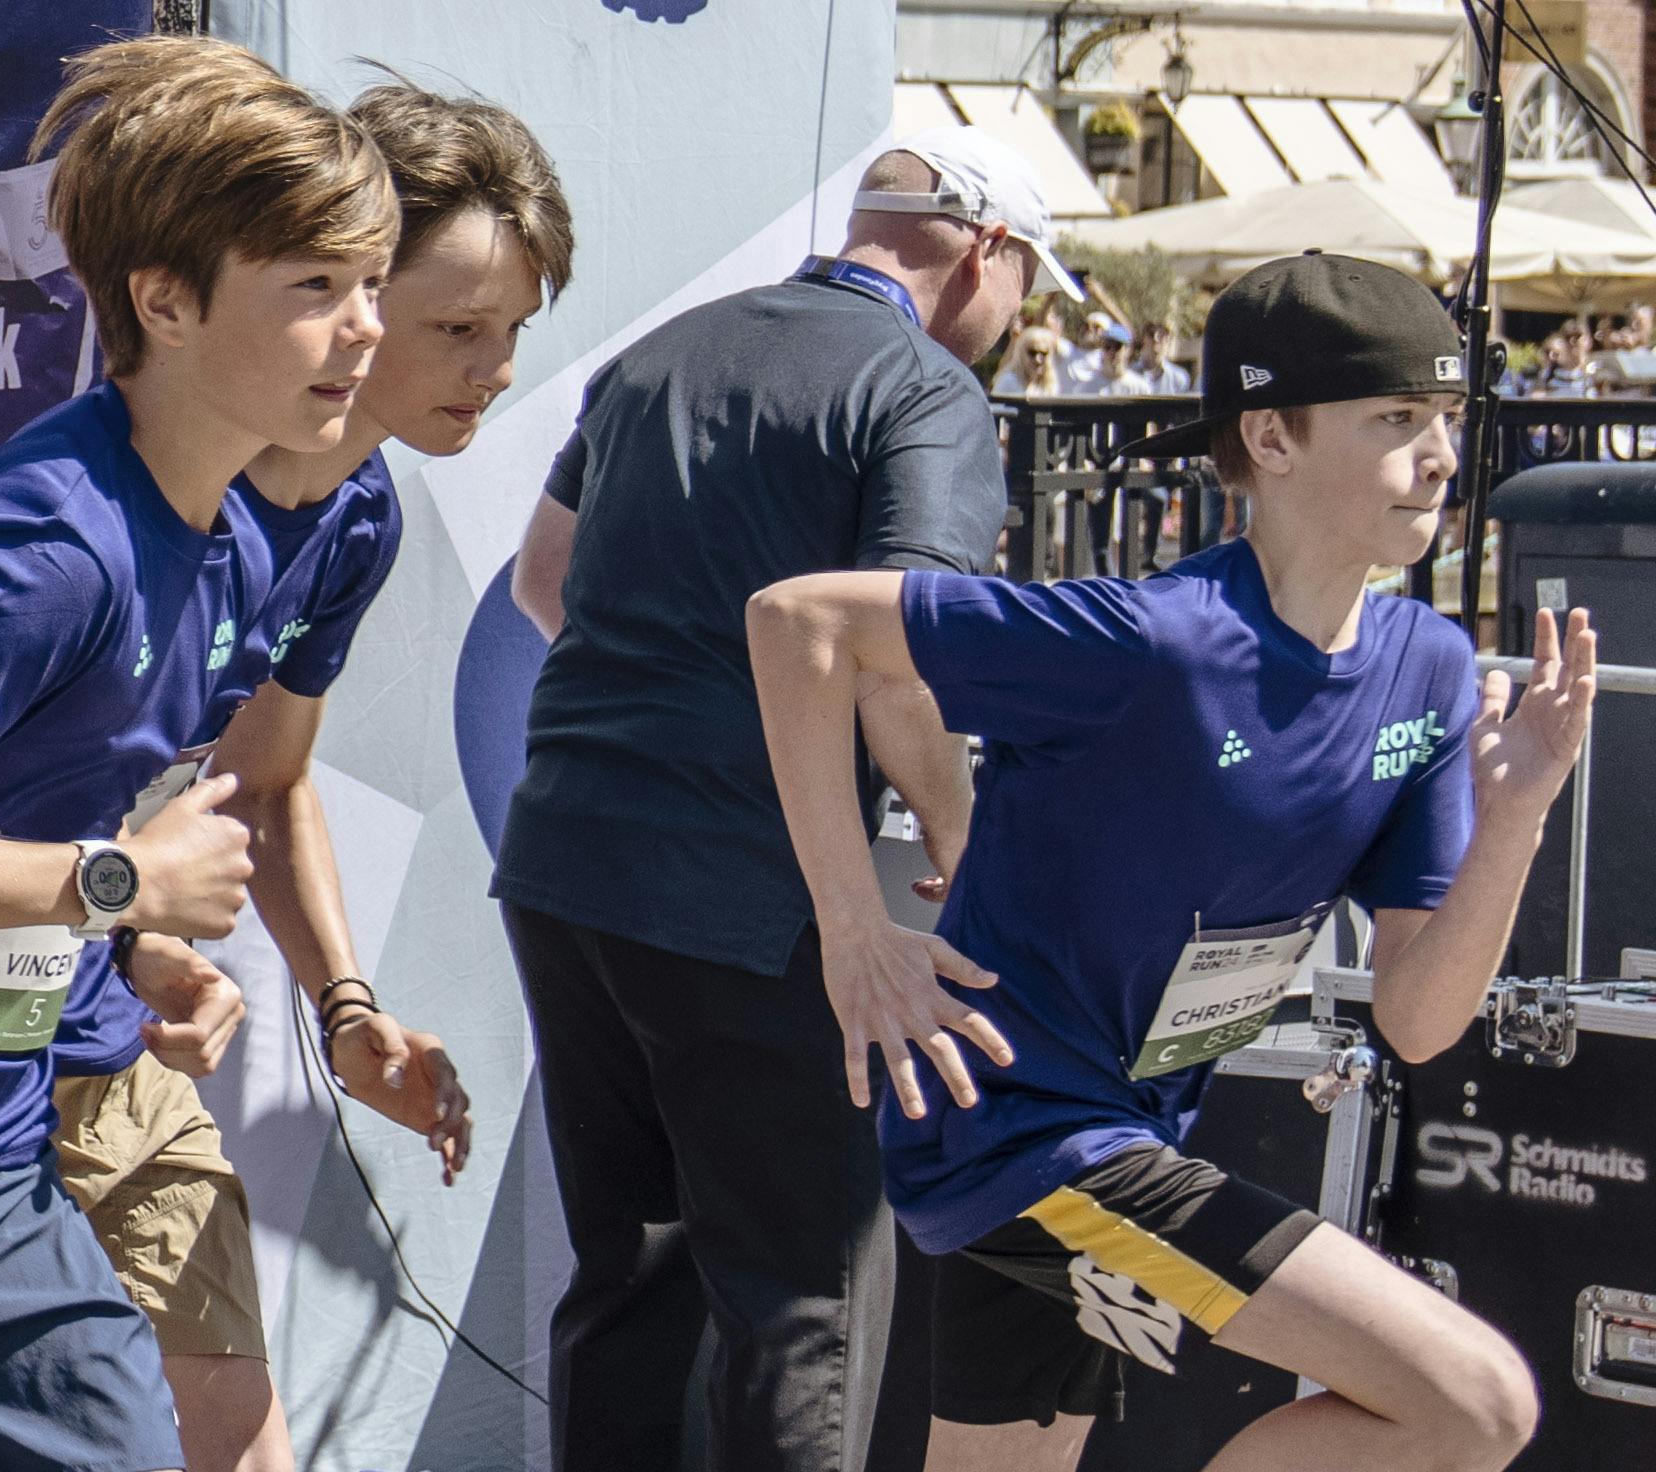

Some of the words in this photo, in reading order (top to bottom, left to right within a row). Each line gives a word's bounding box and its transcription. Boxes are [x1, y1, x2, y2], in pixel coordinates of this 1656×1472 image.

[1374, 710, 1445, 753] ROYL
[1195, 947, 1242, 961] ROYAL
[25, 998, 46, 1027] 5
[1171, 982, 1287, 1028] CHRISTIAN
[1158, 1044, 1180, 1063] C
[1511, 1133, 1647, 1182] Schmidts
[1510, 1164, 1596, 1206] Radio
